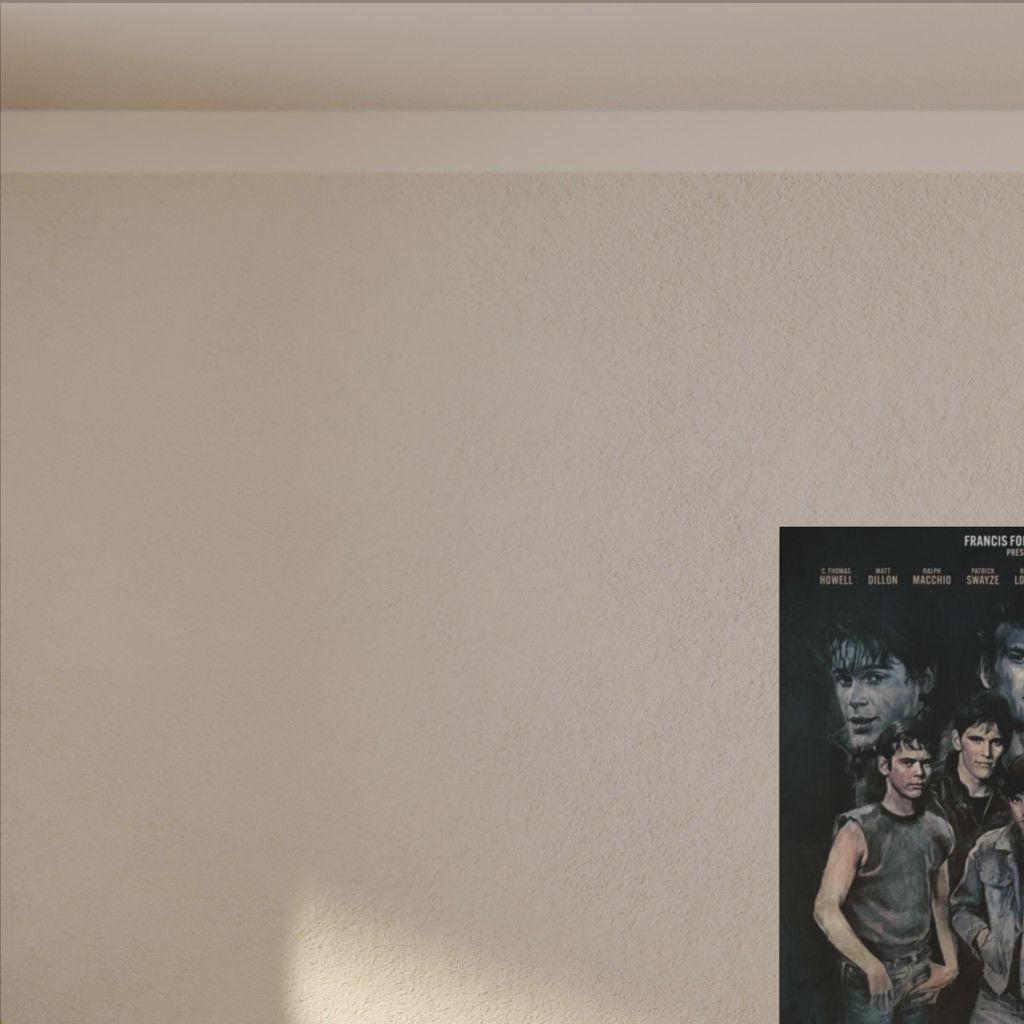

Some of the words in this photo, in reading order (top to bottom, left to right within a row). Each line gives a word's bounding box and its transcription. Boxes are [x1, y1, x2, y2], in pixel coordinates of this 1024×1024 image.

[964, 534, 1008, 547] FRANCIS
[875, 567, 891, 575] MATT
[971, 567, 994, 575] PATRICK
[820, 575, 853, 585] HOWELL
[868, 575, 898, 585] DILLON
[913, 575, 951, 585] MACCHIO
[967, 575, 999, 585] SWAYZE
